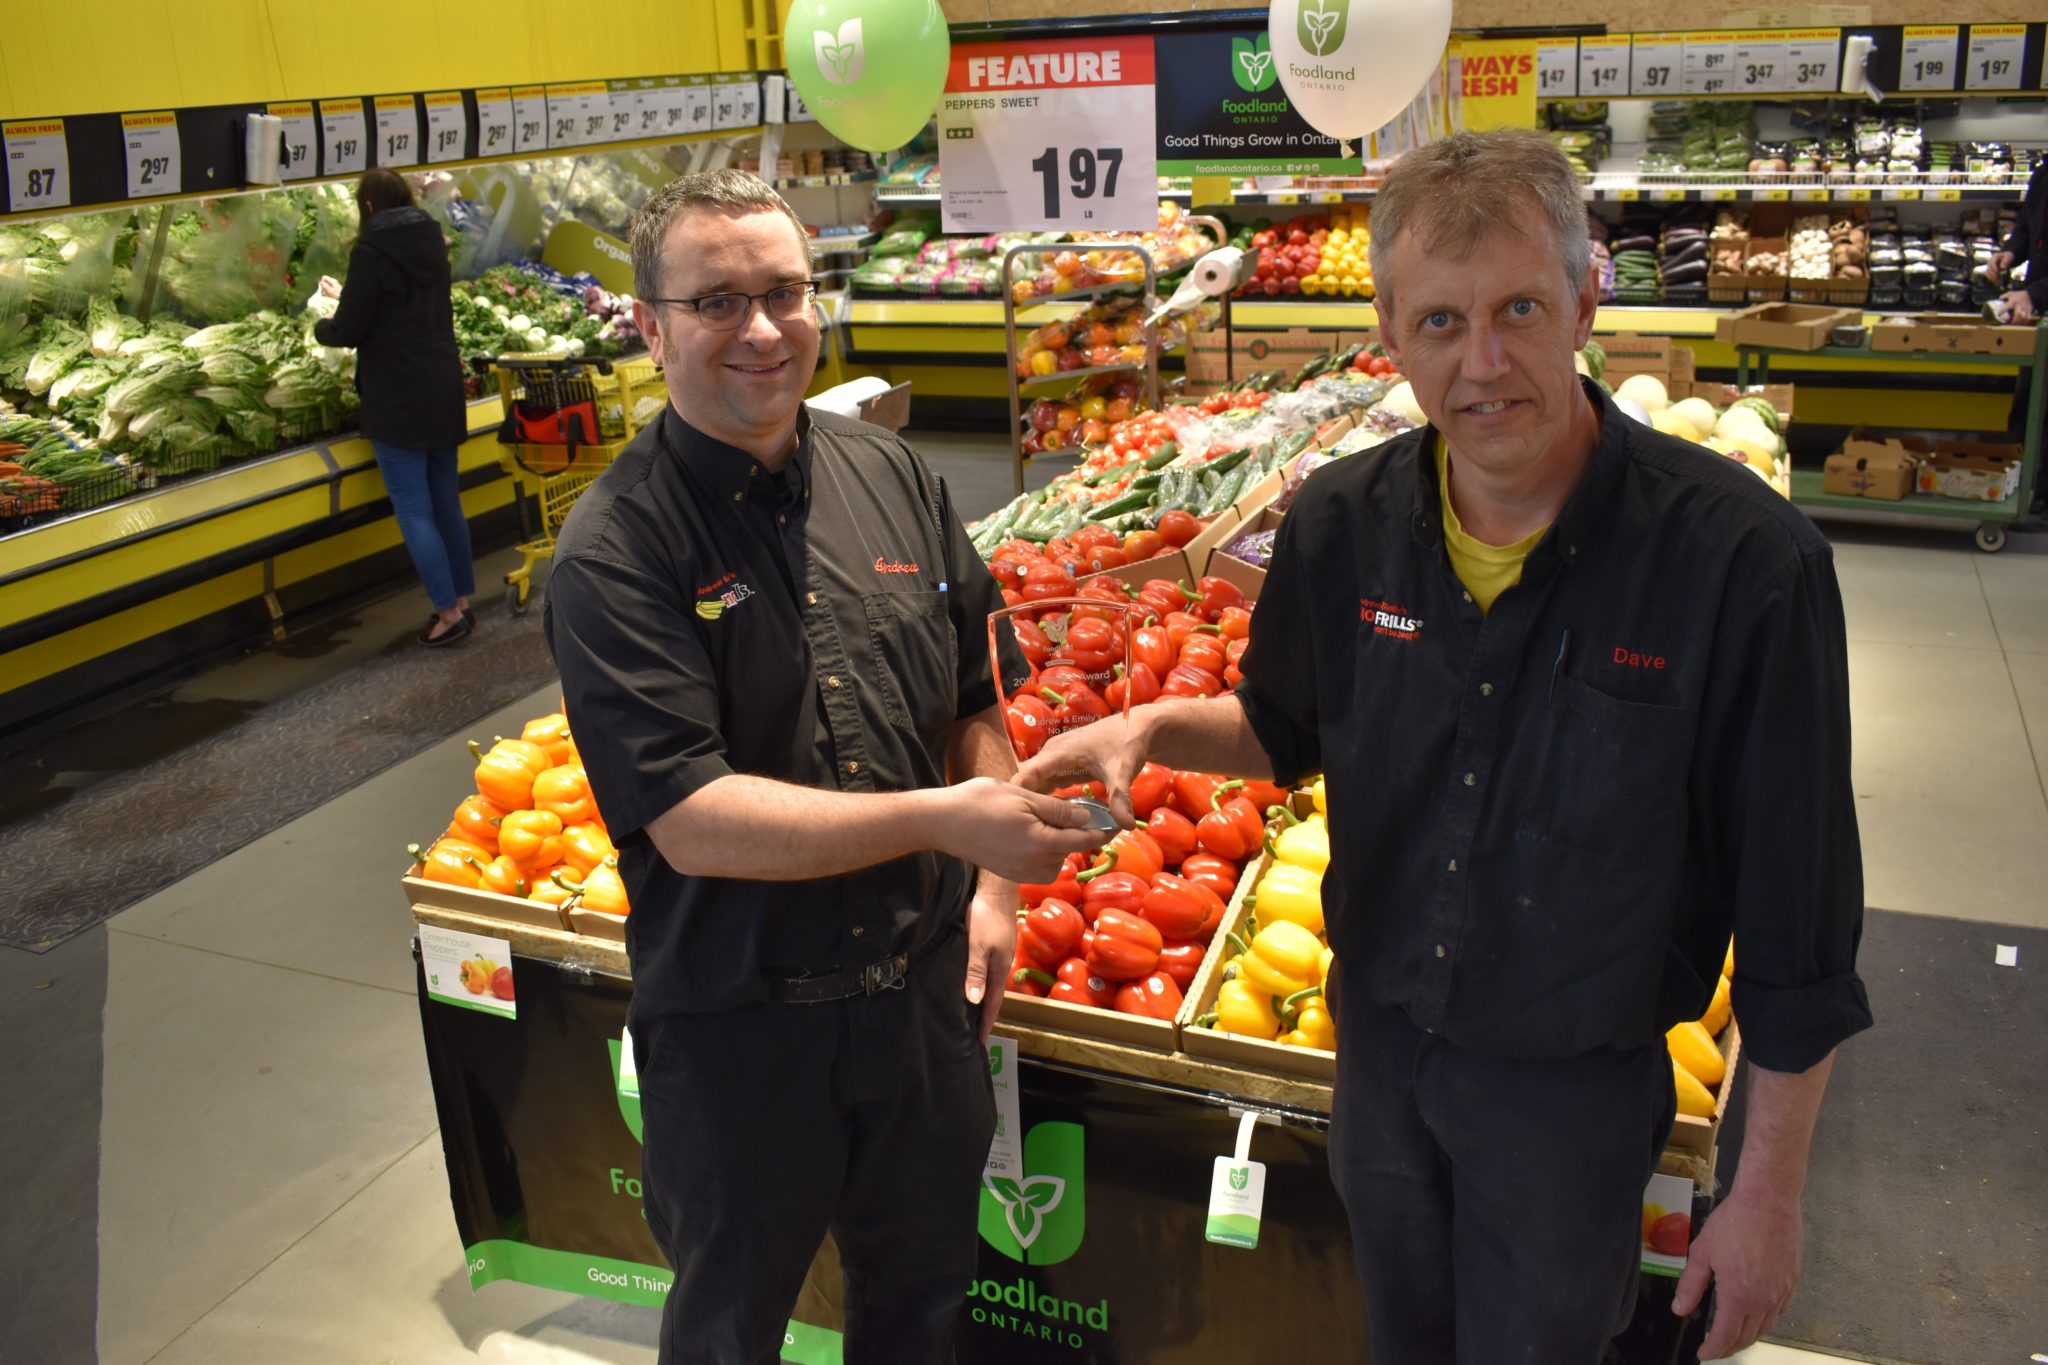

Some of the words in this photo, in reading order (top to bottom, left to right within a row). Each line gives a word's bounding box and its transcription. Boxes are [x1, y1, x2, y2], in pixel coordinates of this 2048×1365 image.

[968, 50, 1121, 88] FEATURE
[1289, 63, 1355, 81] Foodland
[1461, 53, 1533, 76] WAYS
[1745, 64, 1774, 85] 347
[1797, 63, 1826, 84] 347
[1914, 60, 1943, 81] 199
[1980, 60, 2010, 81] 197
[1300, 81, 1345, 91] ONTARIO
[1539, 69, 1565, 88] 147
[1591, 68, 1618, 87] 147
[945, 98, 996, 110] PEPPERS
[1001, 96, 1040, 108] SWEET
[1222, 98, 1288, 114] Foodland
[5, 125, 38, 136] ALWAYS
[38, 123, 62, 133] FRESH
[124, 117, 153, 127] ALWAYS
[153, 114, 175, 124] FRESH
[1233, 116, 1278, 124] ONTARIO
[388, 134, 409, 158] 127
[438, 130, 458, 152] 197
[487, 125, 507, 147] 297
[1164, 135, 1199, 148] Good
[1202, 134, 1245, 149] Things
[1248, 133, 1283, 147] Grow
[1287, 133, 1299, 146] in
[1302, 132, 1352, 146] Ontaro
[335, 140, 357, 164] 197
[140, 157, 170, 185] 297
[1195, 163, 1283, 174] foodlandontario.ca
[24, 168, 56, 198] .87
[1032, 147, 1123, 219] 197
[1084, 210, 1093, 219] LB
[593, 236, 632, 265] Organ
[1614, 647, 1665, 669] Dave
[1080, 670, 1110, 681] Award
[1063, 716, 1070, 724] &
[1072, 713, 1102, 724] Emily's
[1048, 727, 1061, 735] No
[1052, 767, 1088, 777] Platinum
[422, 930, 472, 949] Greenhouse
[587, 1267, 628, 1287] Good
[631, 1275, 674, 1293] Thin
[966, 1277, 1108, 1332] oodland
[971, 1307, 1083, 1349] ONTARIO
